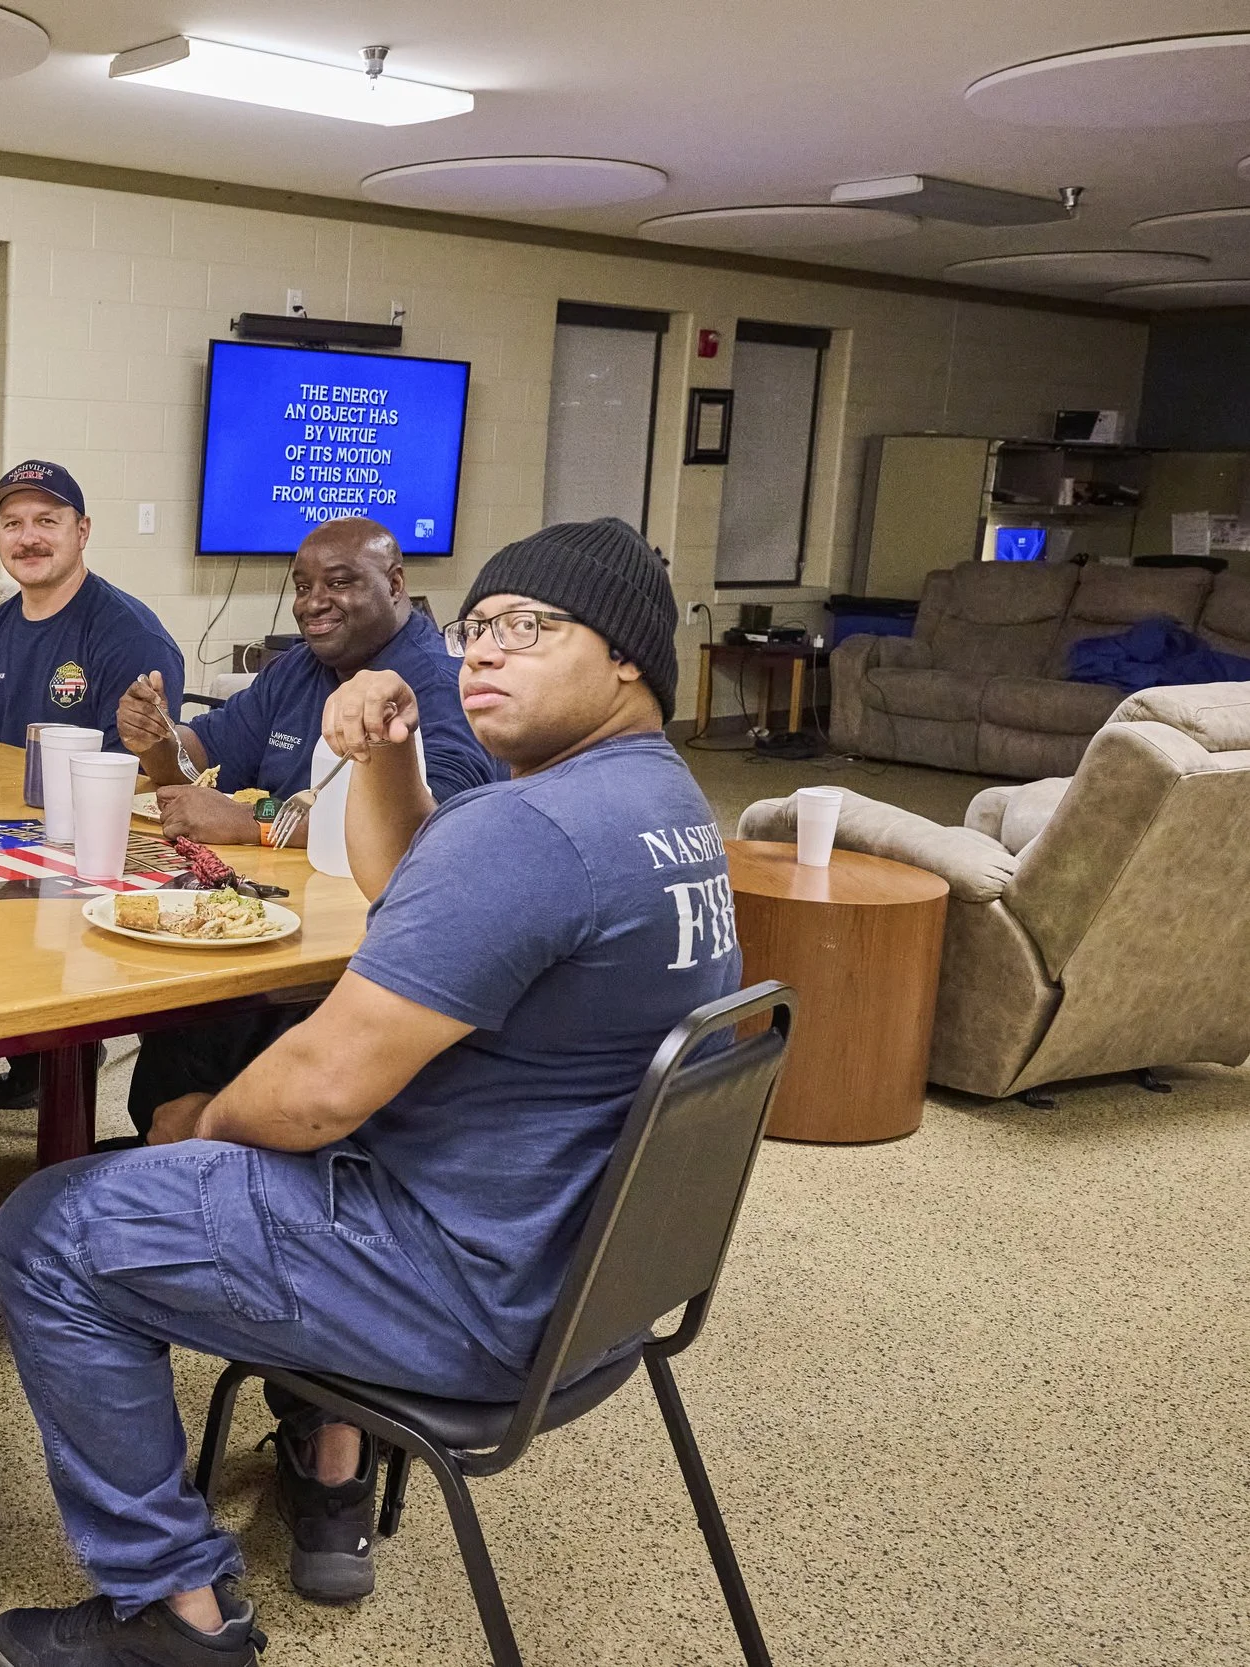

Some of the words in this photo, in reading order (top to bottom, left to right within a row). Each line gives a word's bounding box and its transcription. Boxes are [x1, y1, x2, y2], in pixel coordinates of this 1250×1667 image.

[301, 384, 328, 402] THE
[332, 386, 388, 405] ENERGY
[284, 403, 306, 420] AN
[310, 405, 365, 424] OBJECT
[369, 409, 398, 425] HAS
[305, 425, 324, 441] BY
[327, 426, 377, 444] VIRTUE
[285, 445, 305, 461] OF
[310, 446, 333, 462] ITS
[336, 448, 391, 464] MOTION
[8, 464, 53, 480] NASHVILLE
[12, 470, 44, 482] FIRE
[290, 466, 305, 481] IS
[310, 466, 342, 483] THIS
[346, 468, 383, 487] KIND,
[272, 486, 314, 502] FROM
[319, 487, 365, 503] GREEK
[368, 488, 397, 505] FOR
[268, 738, 294, 750] ENGINEER
[270, 731, 302, 745] LAWRENCE
[638, 822, 726, 870] NASHVI
[664, 873, 737, 970] FIR
